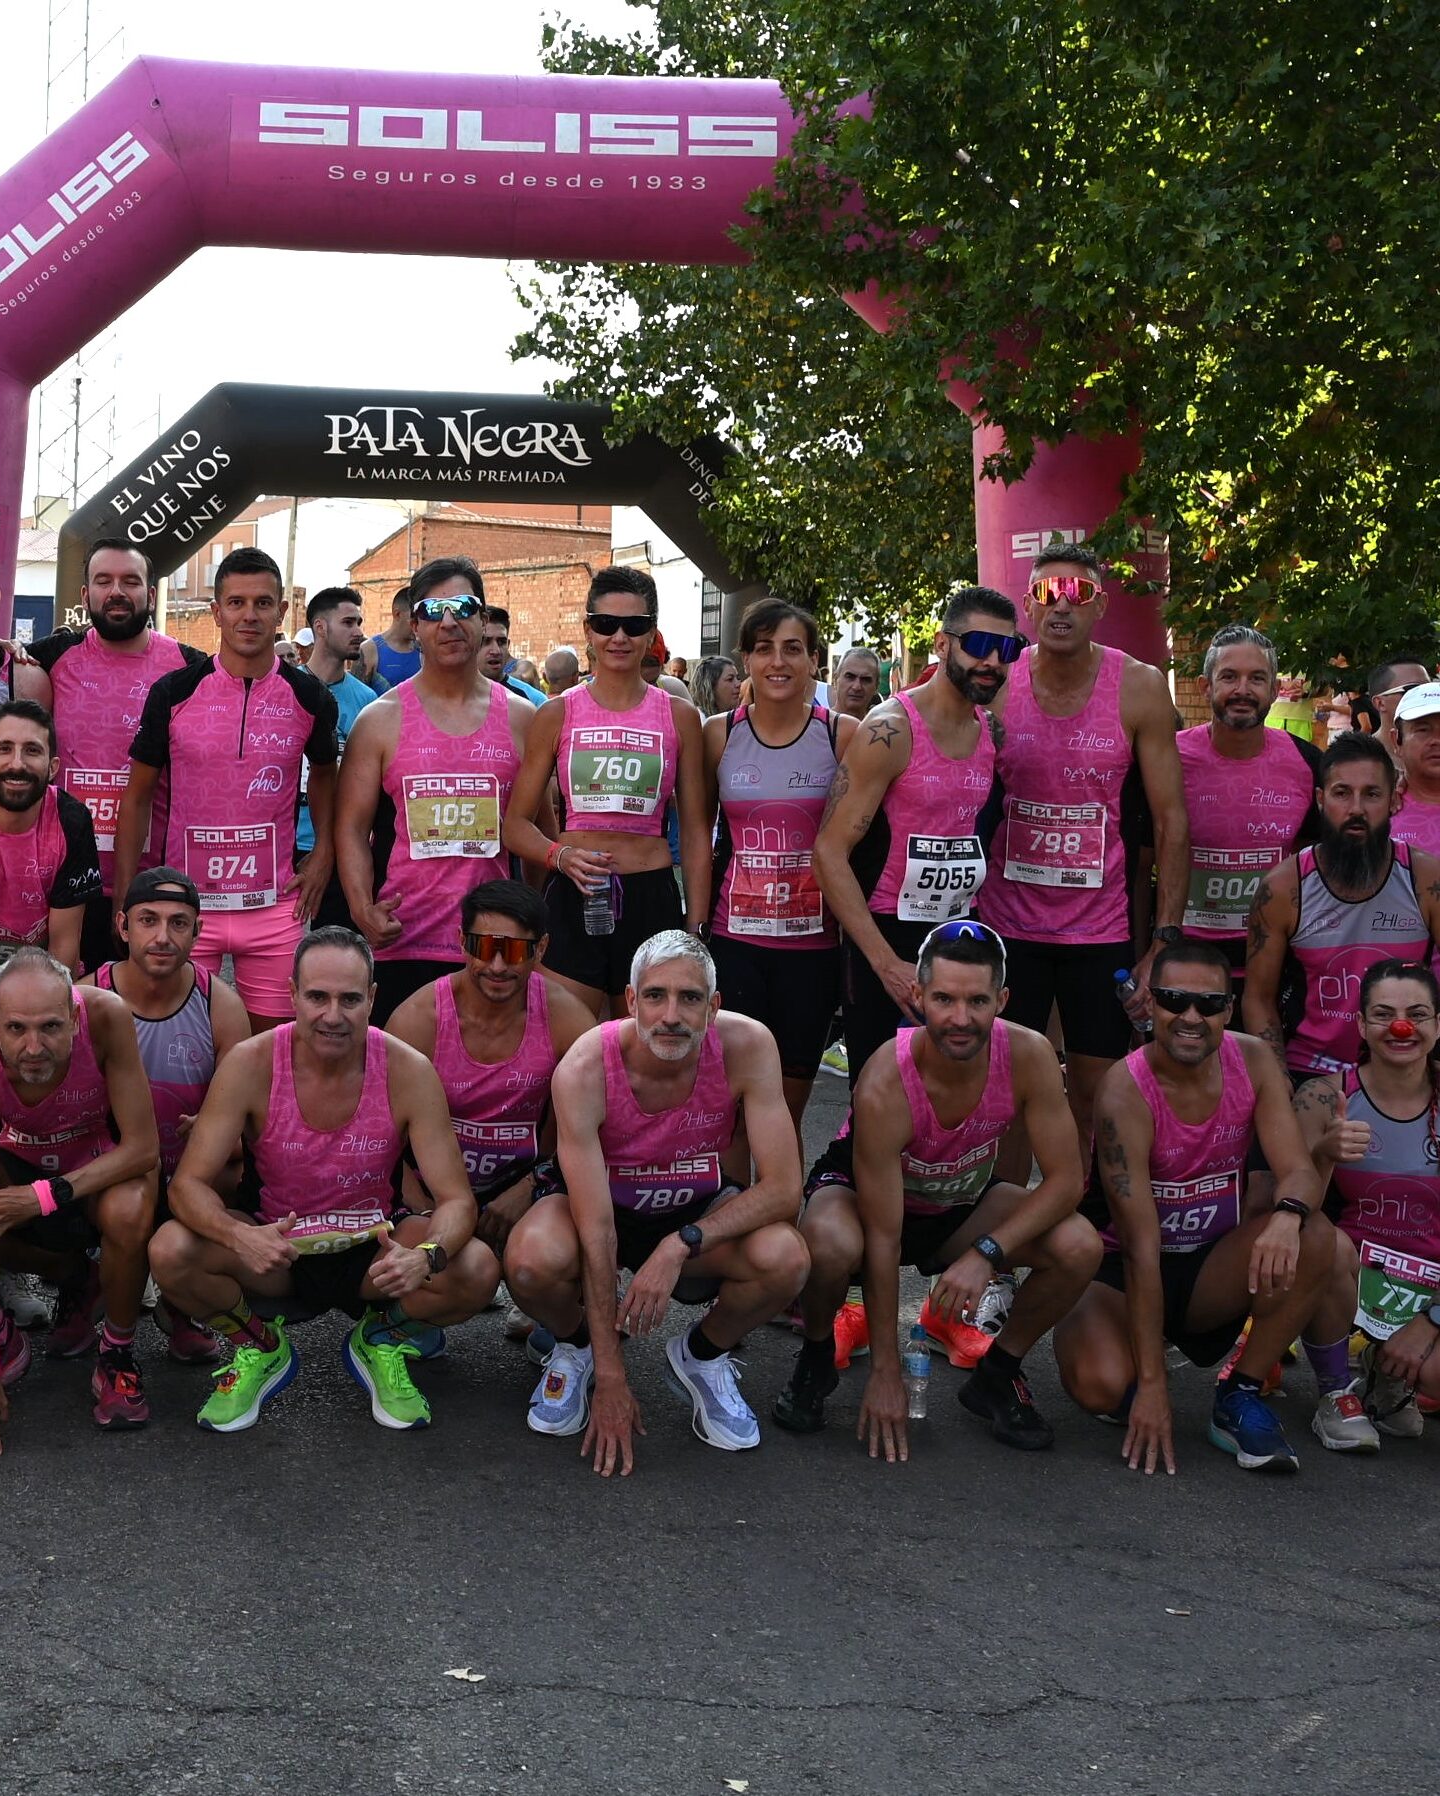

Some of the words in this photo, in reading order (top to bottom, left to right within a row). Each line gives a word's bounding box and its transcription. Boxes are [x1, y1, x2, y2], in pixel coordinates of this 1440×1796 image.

[259, 102, 777, 157] SOLISS
[328, 165, 477, 186] Seguros
[499, 172, 604, 190] desde
[628, 175, 707, 190] 1933
[62, 224, 104, 262] desde
[108, 191, 142, 222] 1933
[323, 406, 431, 457] PATA
[110, 487, 142, 515] EL
[136, 430, 201, 486] VINO
[347, 467, 366, 479] LA
[371, 468, 432, 481] MARCA
[437, 467, 472, 482] MÁS
[478, 470, 566, 483] PREMIADA
[127, 492, 181, 543] QUE
[176, 446, 231, 500] NOS
[172, 494, 227, 542] UNE
[580, 731, 653, 747] SOLISS
[72, 773, 129, 786] SOLIS
[592, 757, 641, 781] 760
[412, 779, 491, 791] SOLISS
[431, 804, 476, 826] 105
[1017, 802, 1097, 820] SOLISS
[194, 829, 267, 843] SOLISS
[916, 839, 975, 853] SOLISS
[1029, 829, 1081, 854] 798
[208, 855, 257, 879] 874
[742, 856, 811, 869] SOLISS
[1194, 852, 1273, 865] SOLISS
[917, 867, 976, 890] 5055
[1206, 877, 1260, 900] 804
[6, 1126, 90, 1145] SOLISS
[634, 1188, 694, 1210] 780
[1161, 1205, 1218, 1232] 467
[1368, 1248, 1440, 1283] SOLIS
